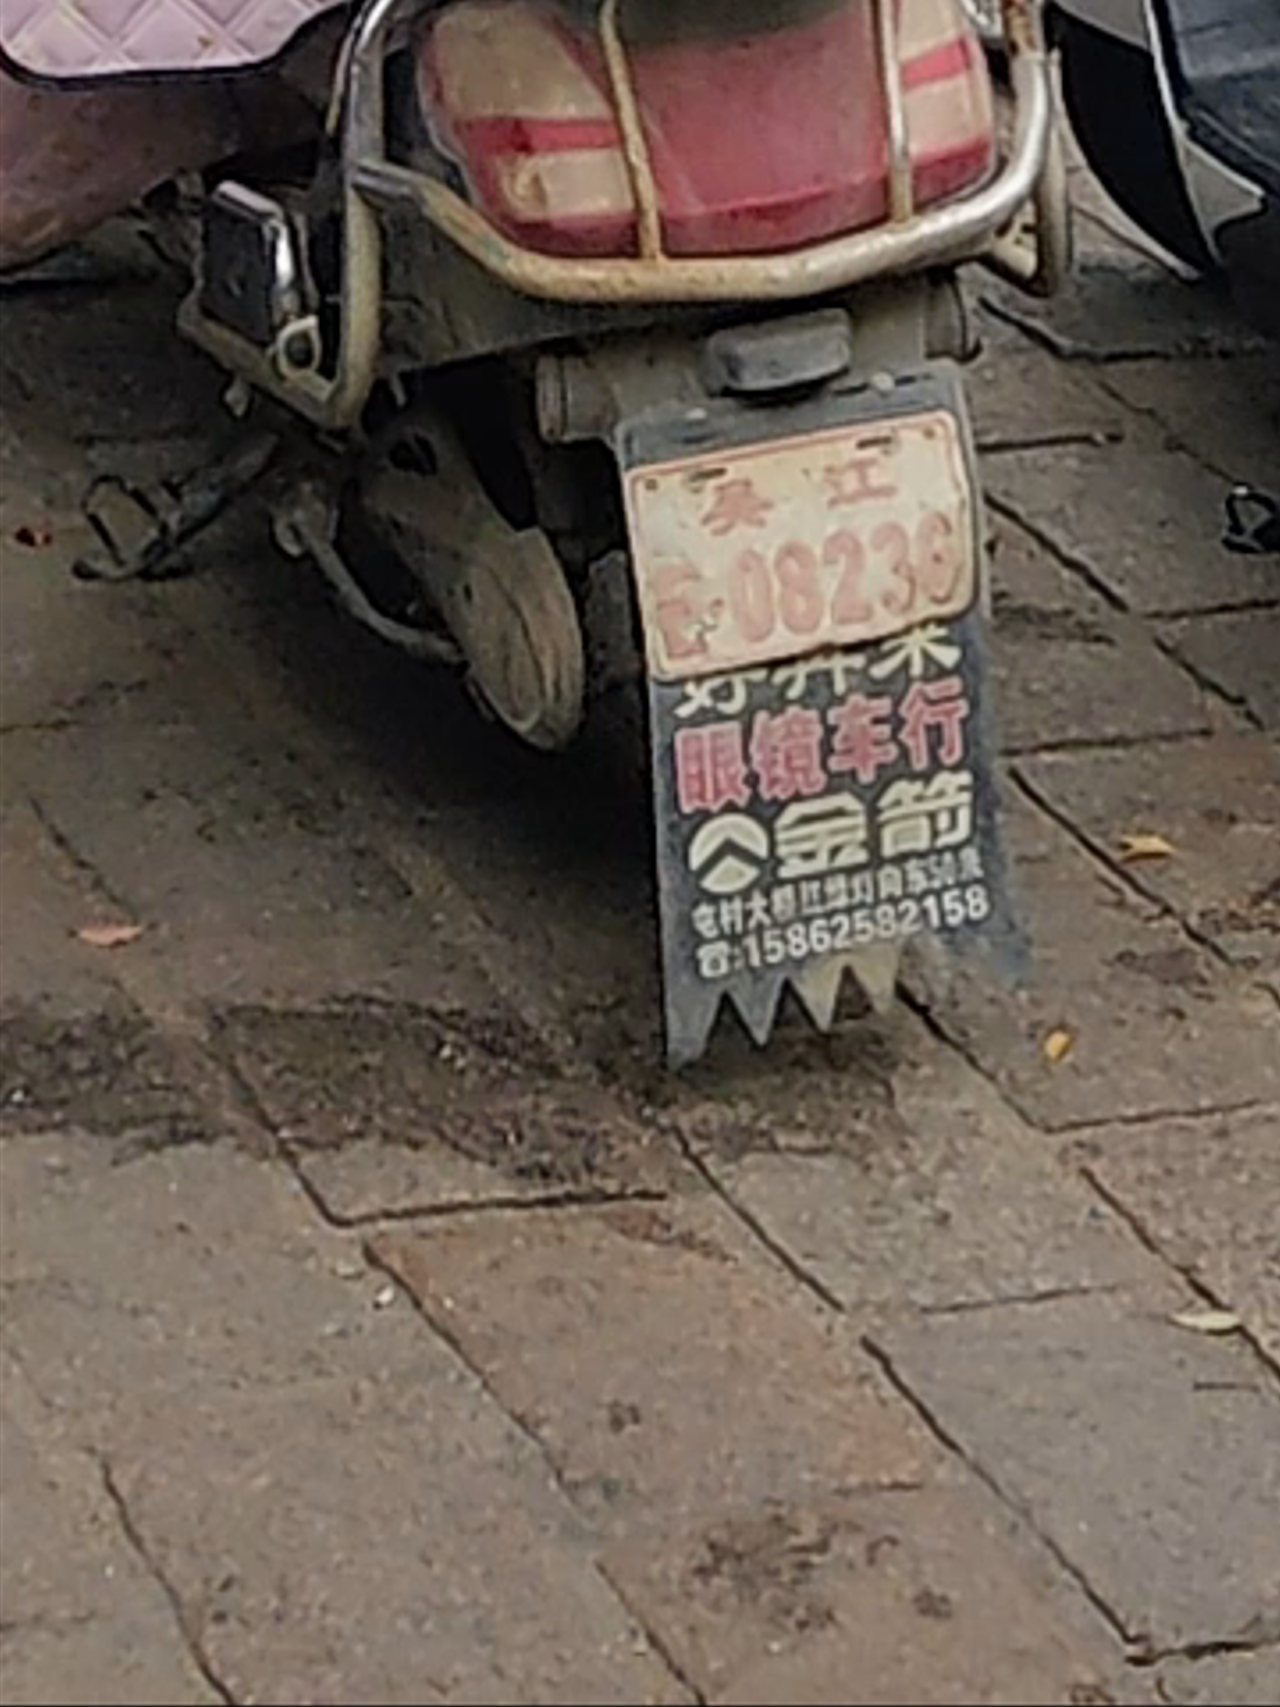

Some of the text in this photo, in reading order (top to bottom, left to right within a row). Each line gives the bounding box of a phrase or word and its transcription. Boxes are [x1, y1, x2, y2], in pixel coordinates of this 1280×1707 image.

[674, 676, 970, 814] 眼镜车行
[774, 769, 974, 879] 金箭
